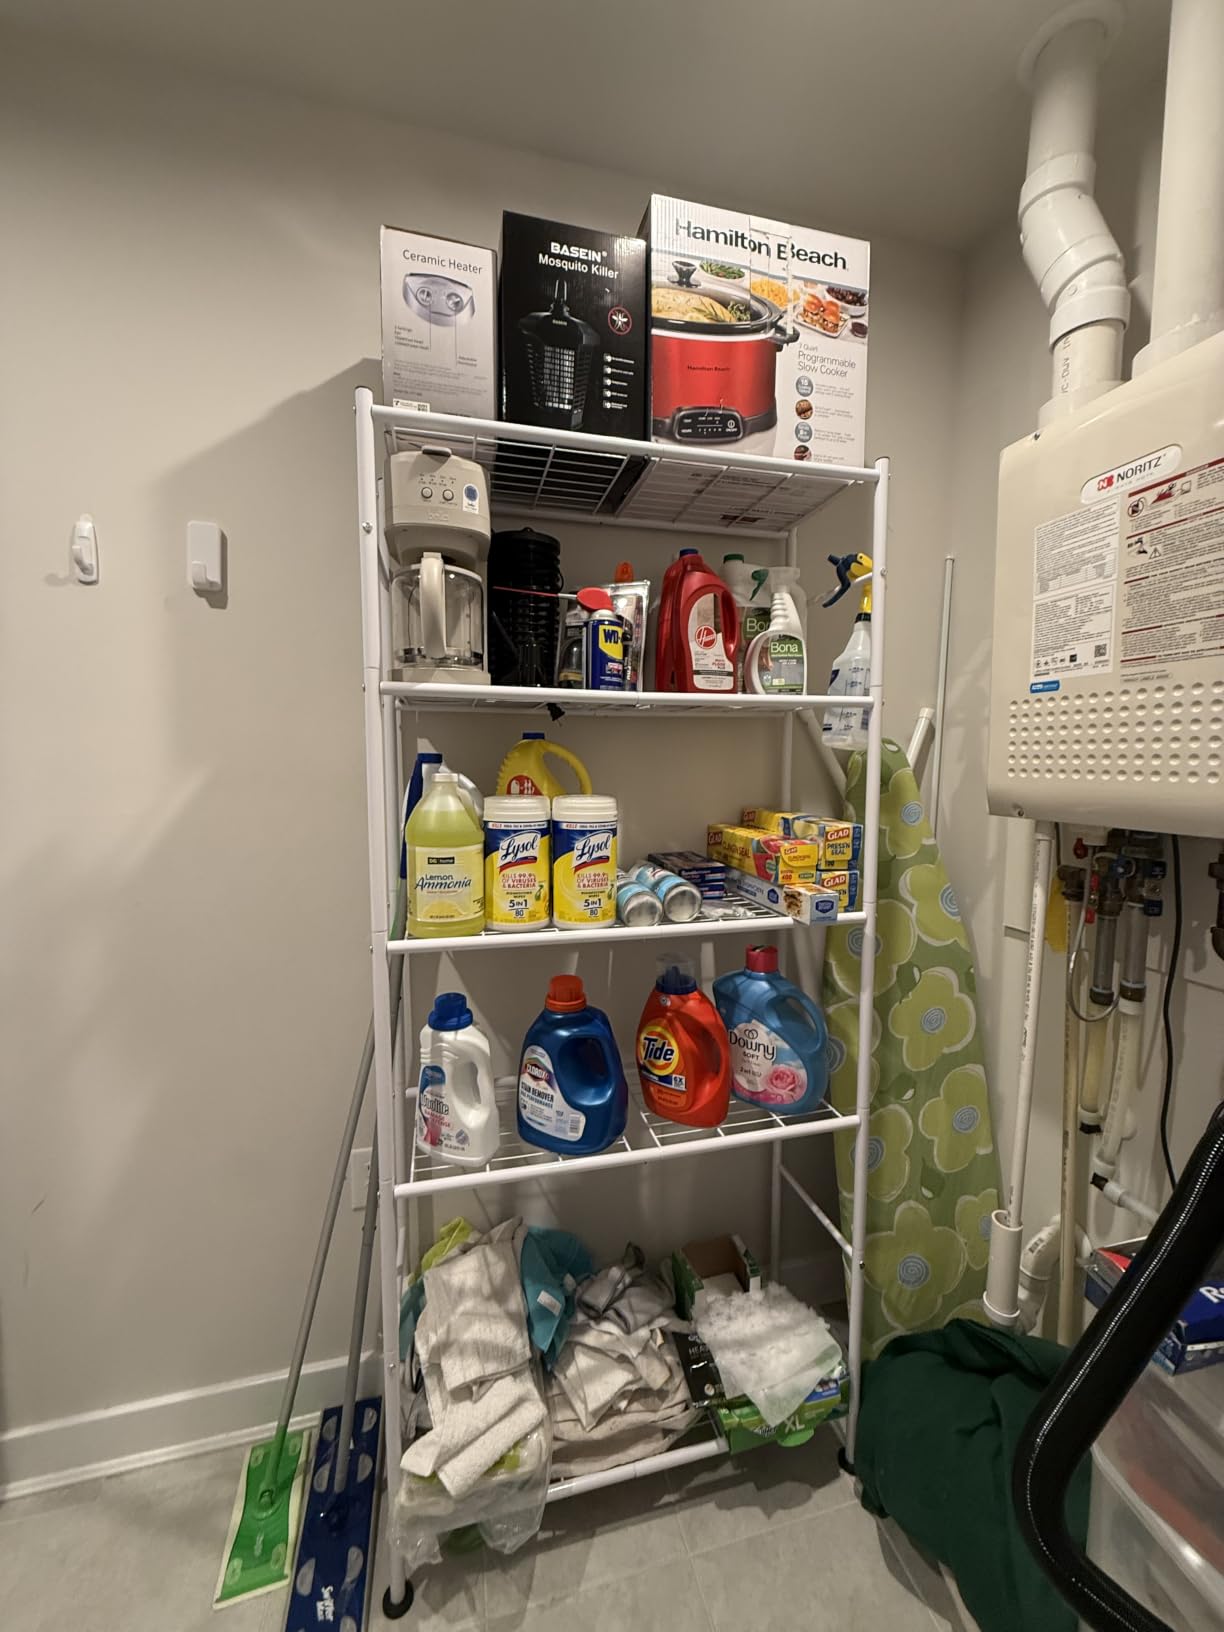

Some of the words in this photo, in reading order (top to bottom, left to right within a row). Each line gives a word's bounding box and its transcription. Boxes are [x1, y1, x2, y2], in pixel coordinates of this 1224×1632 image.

[550, 241, 602, 263] BASEIN
[676, 218, 771, 258] Hamilton
[777, 243, 847, 270] Beach
[402, 249, 447, 267] Ceramic
[448, 258, 482, 275] Heater
[538, 253, 589, 273] Mosquito
[591, 264, 619, 279] Killer
[798, 351, 856, 369] Programmable
[798, 360, 818, 373] Slow
[820, 365, 848, 378] Cooker
[1116, 455, 1162, 482] NORITZ
[746, 617, 769, 632] Bo
[770, 641, 798, 653] Bona
[827, 828, 849, 840] GLAD
[501, 834, 538, 861] Lysol
[576, 834, 610, 861] Lysol
[414, 876, 472, 892] Ammonia
[823, 875, 846, 887] GLAD
[509, 900, 515, 908] 5
[524, 899, 528, 907] 1
[583, 899, 590, 907] 5
[643, 1037, 675, 1061] Tide
[729, 1030, 775, 1060] Downy
[531, 1086, 554, 1102] REMOVER
